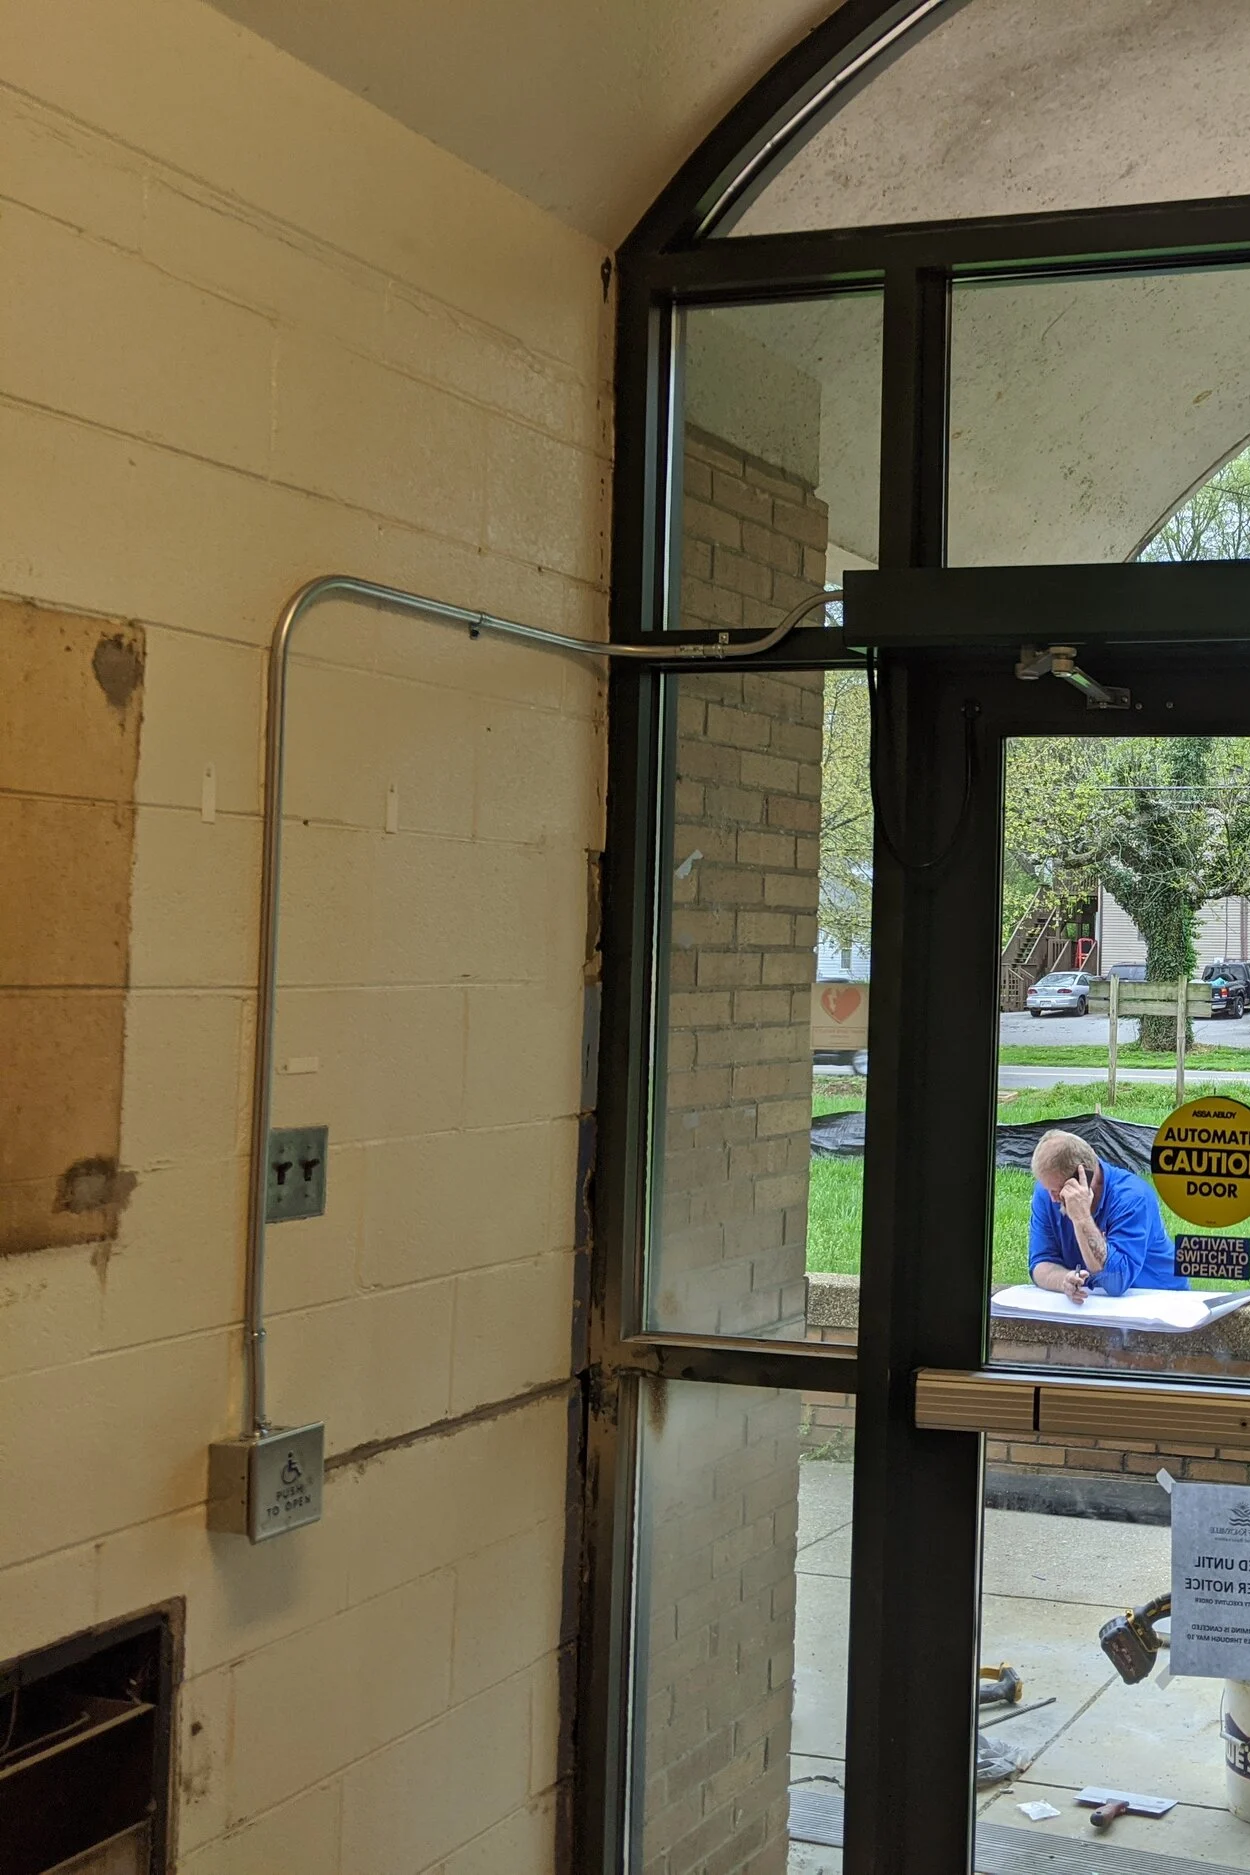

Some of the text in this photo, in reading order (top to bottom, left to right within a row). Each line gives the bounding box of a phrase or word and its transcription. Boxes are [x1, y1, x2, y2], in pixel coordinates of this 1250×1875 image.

[1192, 1110, 1237, 1119] ASSA ABLOY
[1186, 1181, 1238, 1198] DOOR
[1180, 1236, 1244, 1252] ACTIVATE
[1176, 1250, 1249, 1265] SWITCH TO
[1180, 1263, 1243, 1278] OPERATE
[276, 1484, 304, 1501] PUSH
[266, 1494, 311, 1516] TO OPEN
